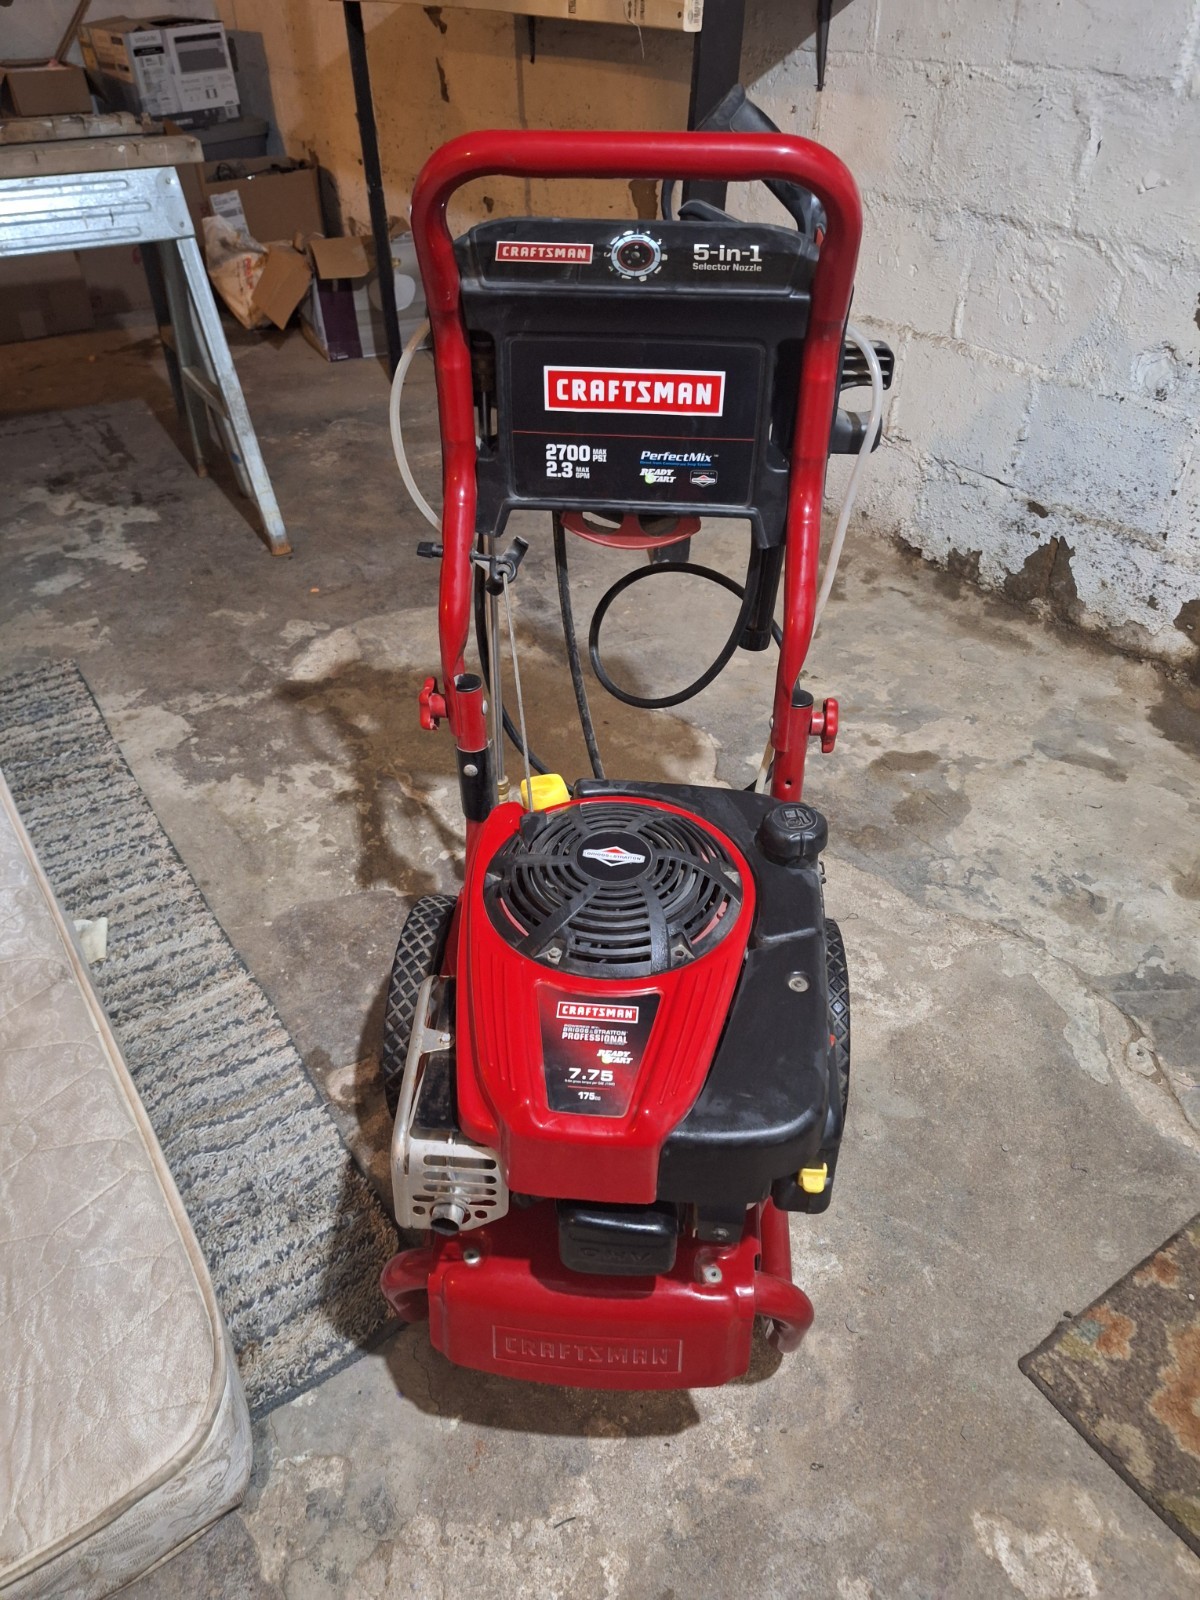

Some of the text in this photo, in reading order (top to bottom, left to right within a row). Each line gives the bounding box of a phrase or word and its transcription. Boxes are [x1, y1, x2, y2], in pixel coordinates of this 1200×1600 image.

[502, 246, 587, 259] CRAFTSMAN
[693, 244, 762, 262] 5-in-1
[692, 262, 762, 272] Selector Nozzle
[556, 378, 713, 405] CRAFTSMAN
[545, 443, 591, 462] 2700
[592, 454, 607, 463] PSI
[640, 450, 713, 463] PerfectMix
[546, 461, 573, 478] 2.3
[639, 468, 675, 477] READY
[561, 1005, 633, 1019] CRAFTSMAN
[561, 1032, 628, 1044] PROFESSIONAL
[568, 1067, 614, 1082] 7.75
[505, 1337, 669, 1365] CRAFTSMAN
